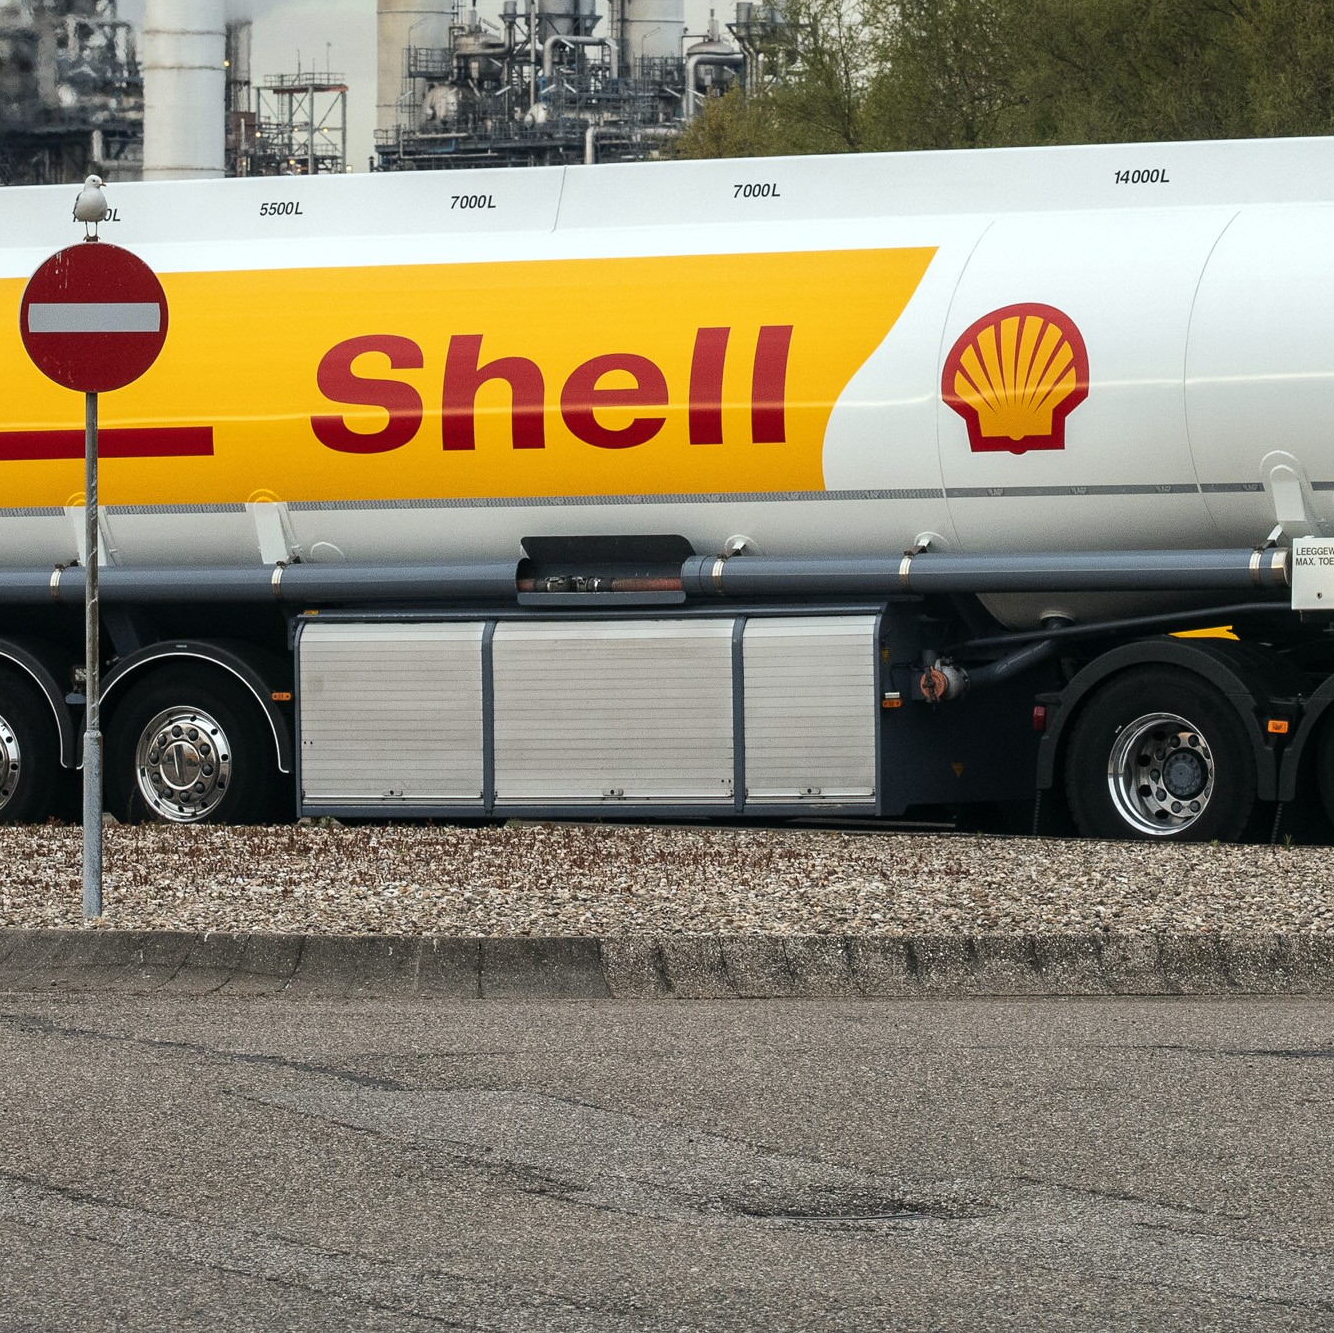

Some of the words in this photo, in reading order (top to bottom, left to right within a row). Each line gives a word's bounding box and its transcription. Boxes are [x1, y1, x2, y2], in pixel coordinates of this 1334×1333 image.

[1114, 169, 1170, 184] 14000L
[733, 183, 781, 198] 7000L
[259, 202, 304, 216] 5500L
[450, 195, 496, 210] 7000L
[311, 324, 793, 455] Shell
[1295, 557, 1316, 566] MAX.
